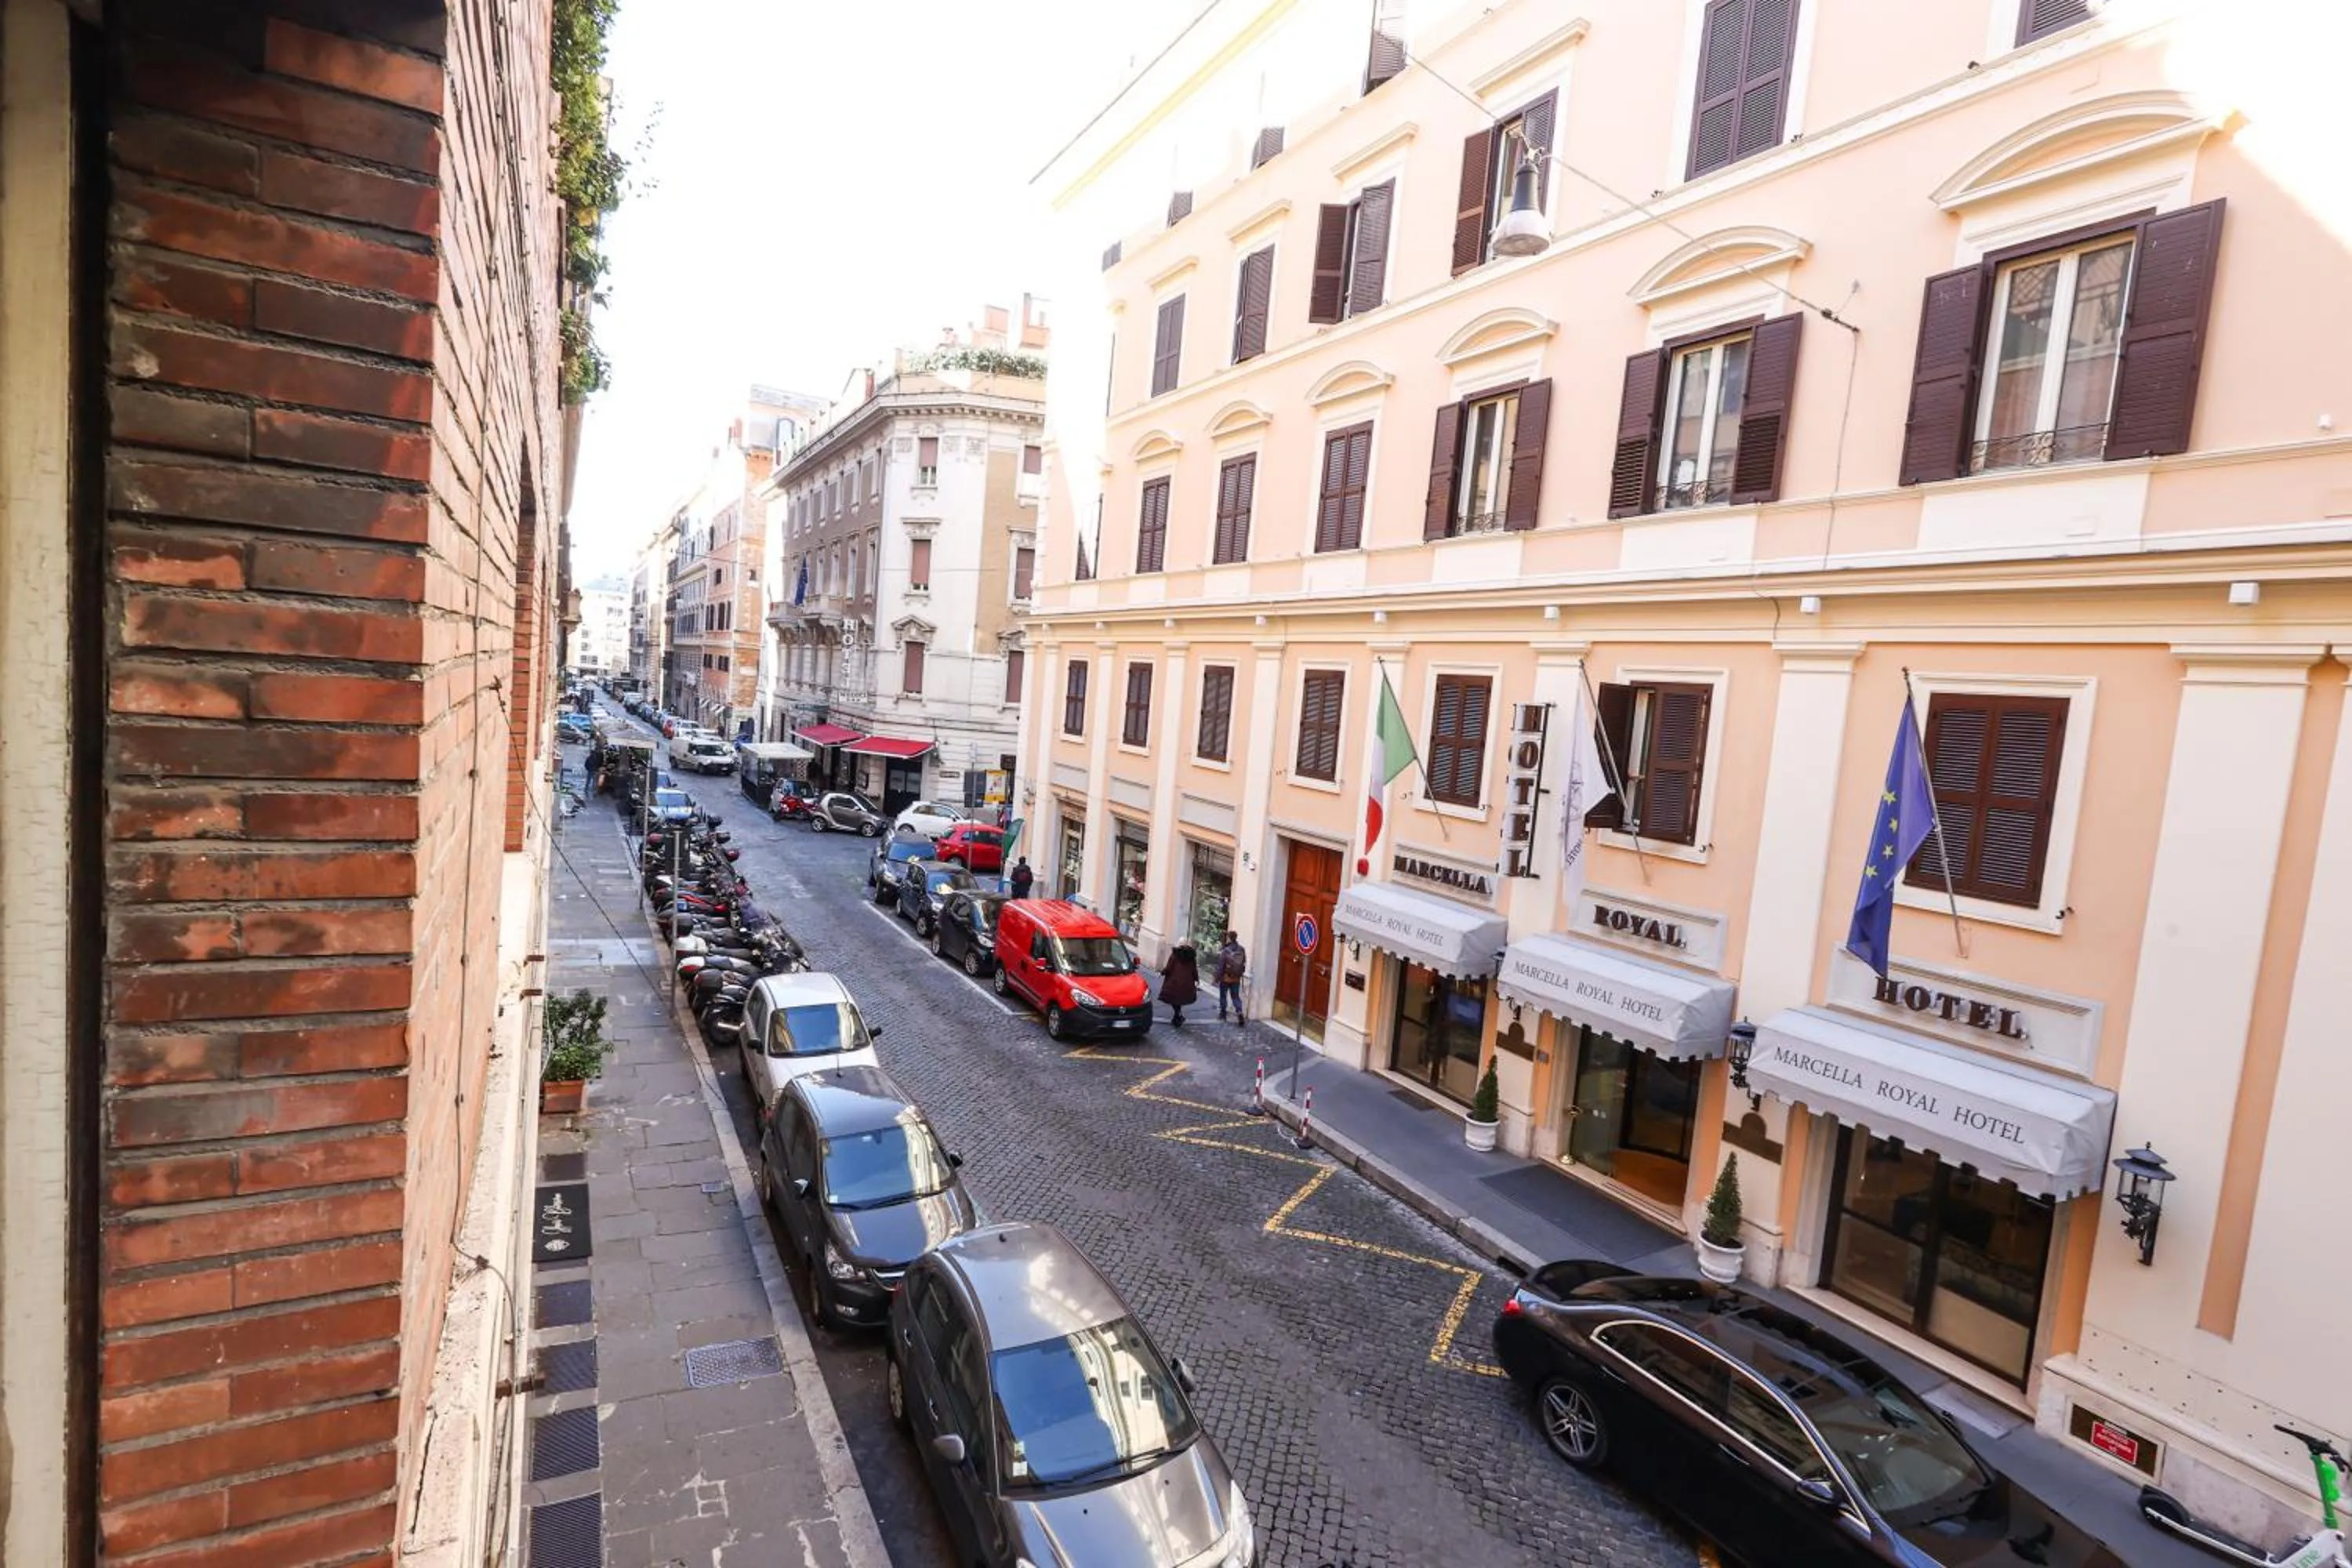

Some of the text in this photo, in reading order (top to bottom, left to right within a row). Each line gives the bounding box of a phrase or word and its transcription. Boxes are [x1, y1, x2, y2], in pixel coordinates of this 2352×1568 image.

[1506, 704, 1543, 877] HOTEL
[1392, 855, 1487, 894] MARCELLA
[1345, 904, 1444, 946] MARCELLA ROYAL HOTEL
[1592, 904, 1683, 948] ROYAL
[1514, 960, 1663, 1022] MARCELLA ROYAL HOTEL
[1872, 975, 2029, 1040] HOTEL
[1773, 1047, 2026, 1145] MARCELLA ROYAL HOTEL
